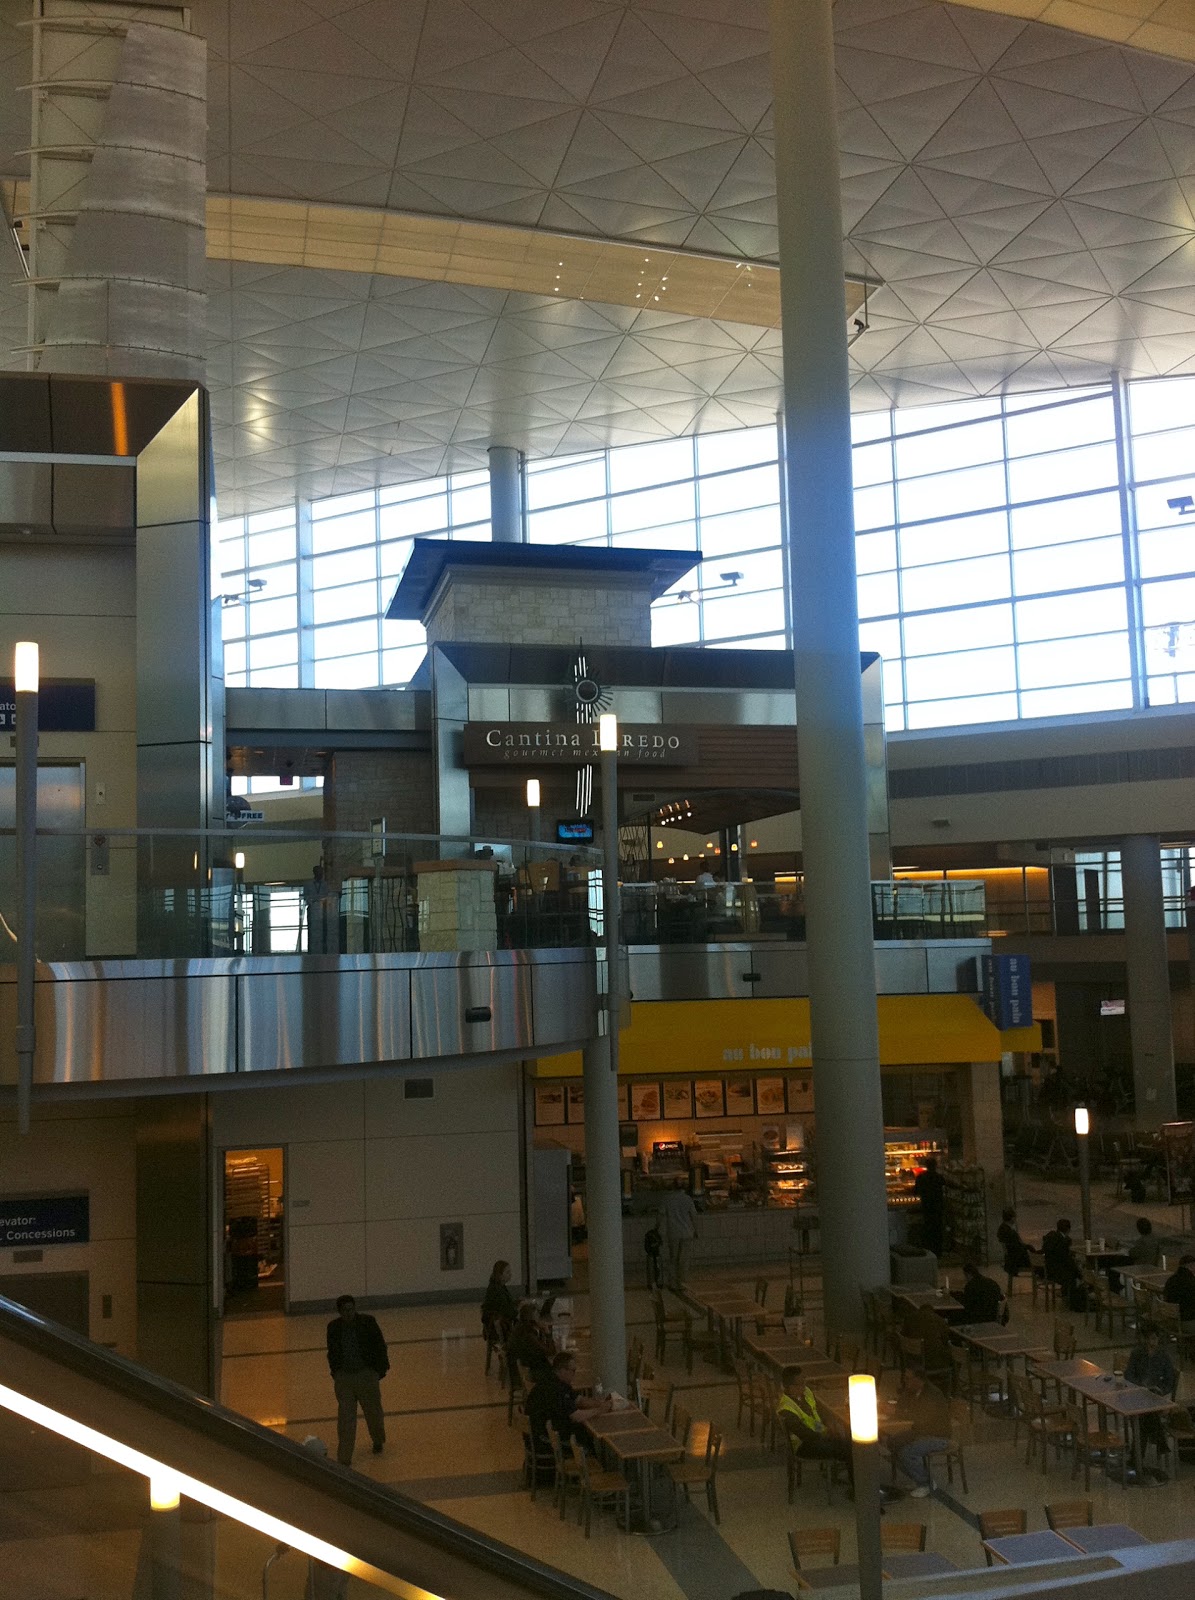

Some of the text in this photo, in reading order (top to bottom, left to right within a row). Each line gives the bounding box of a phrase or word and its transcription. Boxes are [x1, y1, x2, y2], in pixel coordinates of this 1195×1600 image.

[486, 729, 680, 749] Cantina LREDO
[504, 748, 564, 760] gourmet
[636, 748, 666, 760] food
[787, 1041, 812, 1064] pai
[6, 1228, 76, 1240] Concessions
